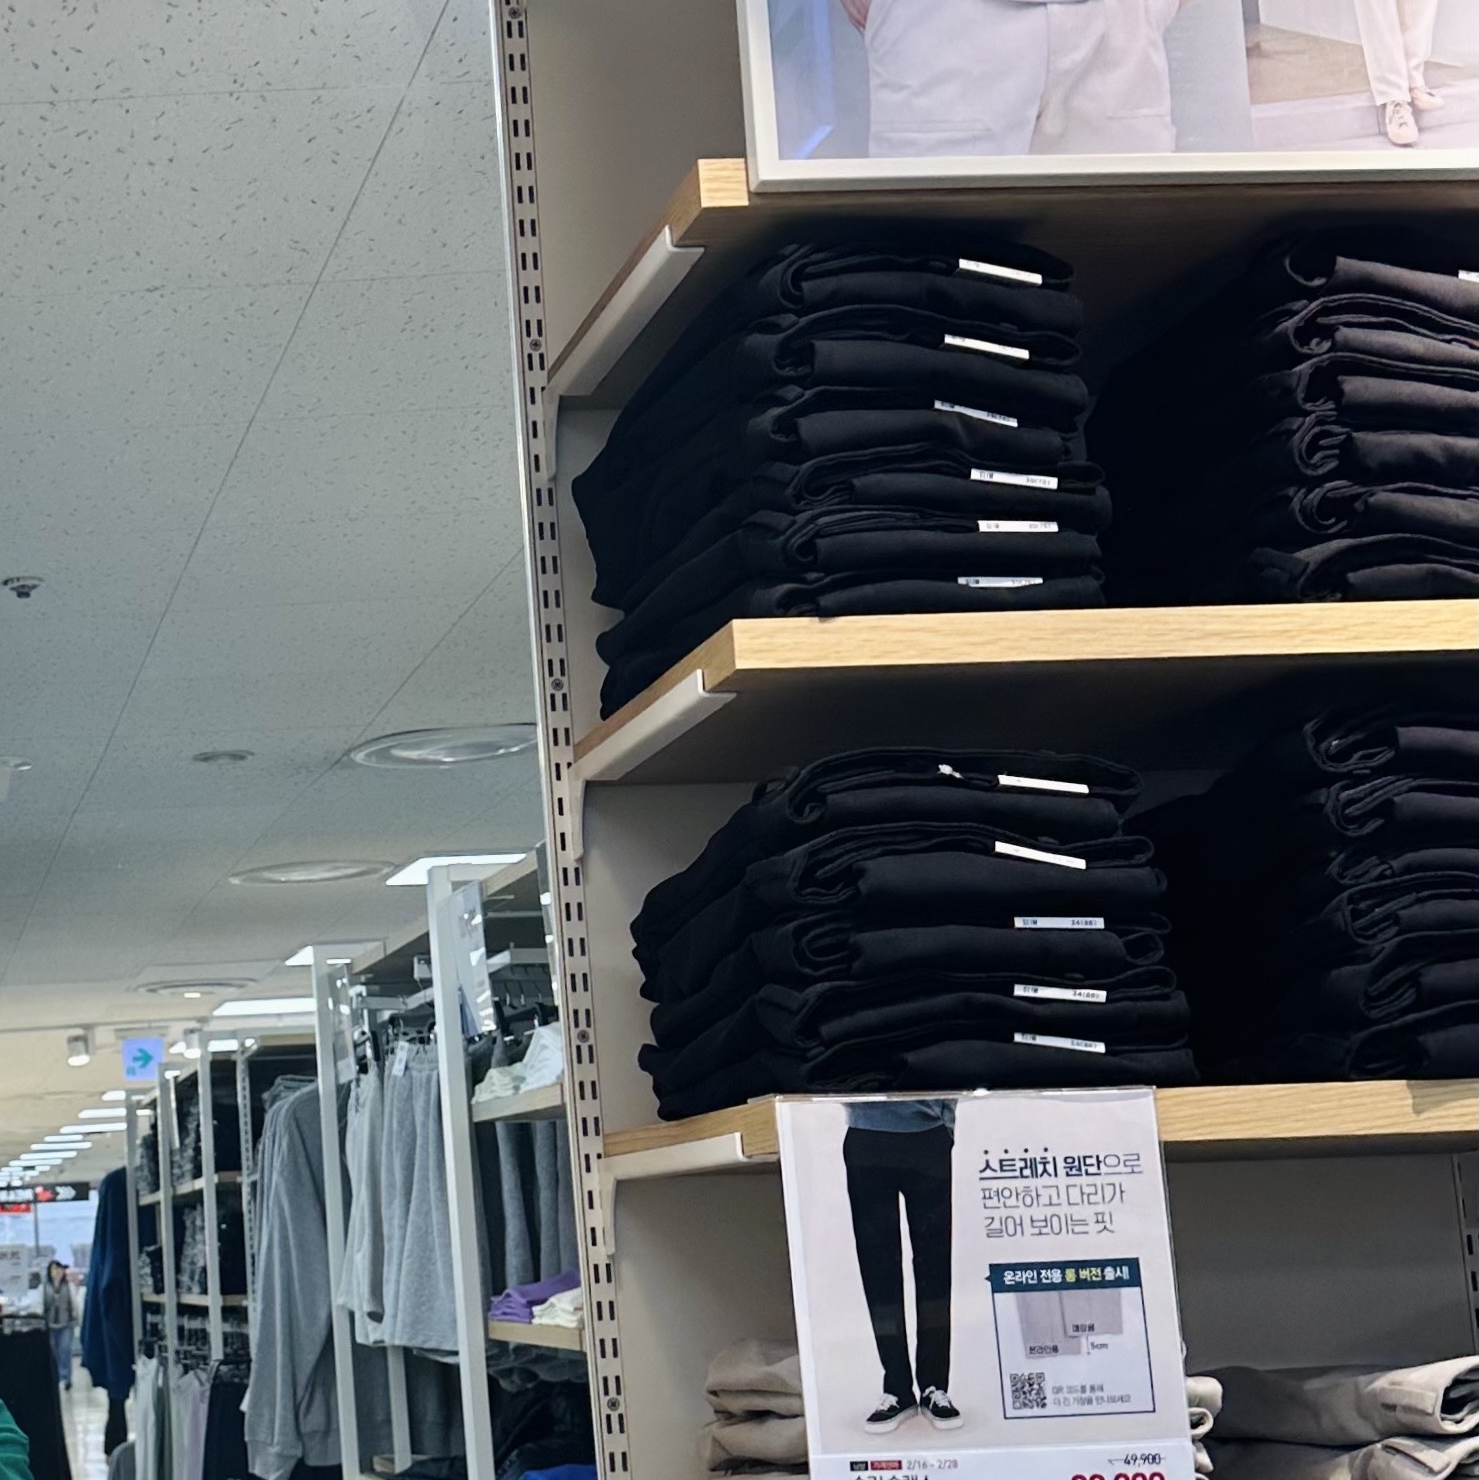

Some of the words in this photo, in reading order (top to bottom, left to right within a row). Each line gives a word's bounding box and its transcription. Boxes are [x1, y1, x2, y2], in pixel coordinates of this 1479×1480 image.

[979, 1156, 1058, 1181] 스트레치
[1063, 1153, 1144, 1177] 원단으로
[981, 1185, 1063, 1209] 편안하고
[1065, 1182, 1125, 1206] 다리가
[984, 1215, 1025, 1239] 길어
[1030, 1212, 1090, 1237] 보이는
[1094, 1210, 1116, 1234] 핏
[1003, 1269, 1038, 1285] 온라인
[1039, 1268, 1063, 1283] 전용
[1079, 1266, 1103, 1281] 버전
[1123, 1453, 1161, 1467] 49,900
